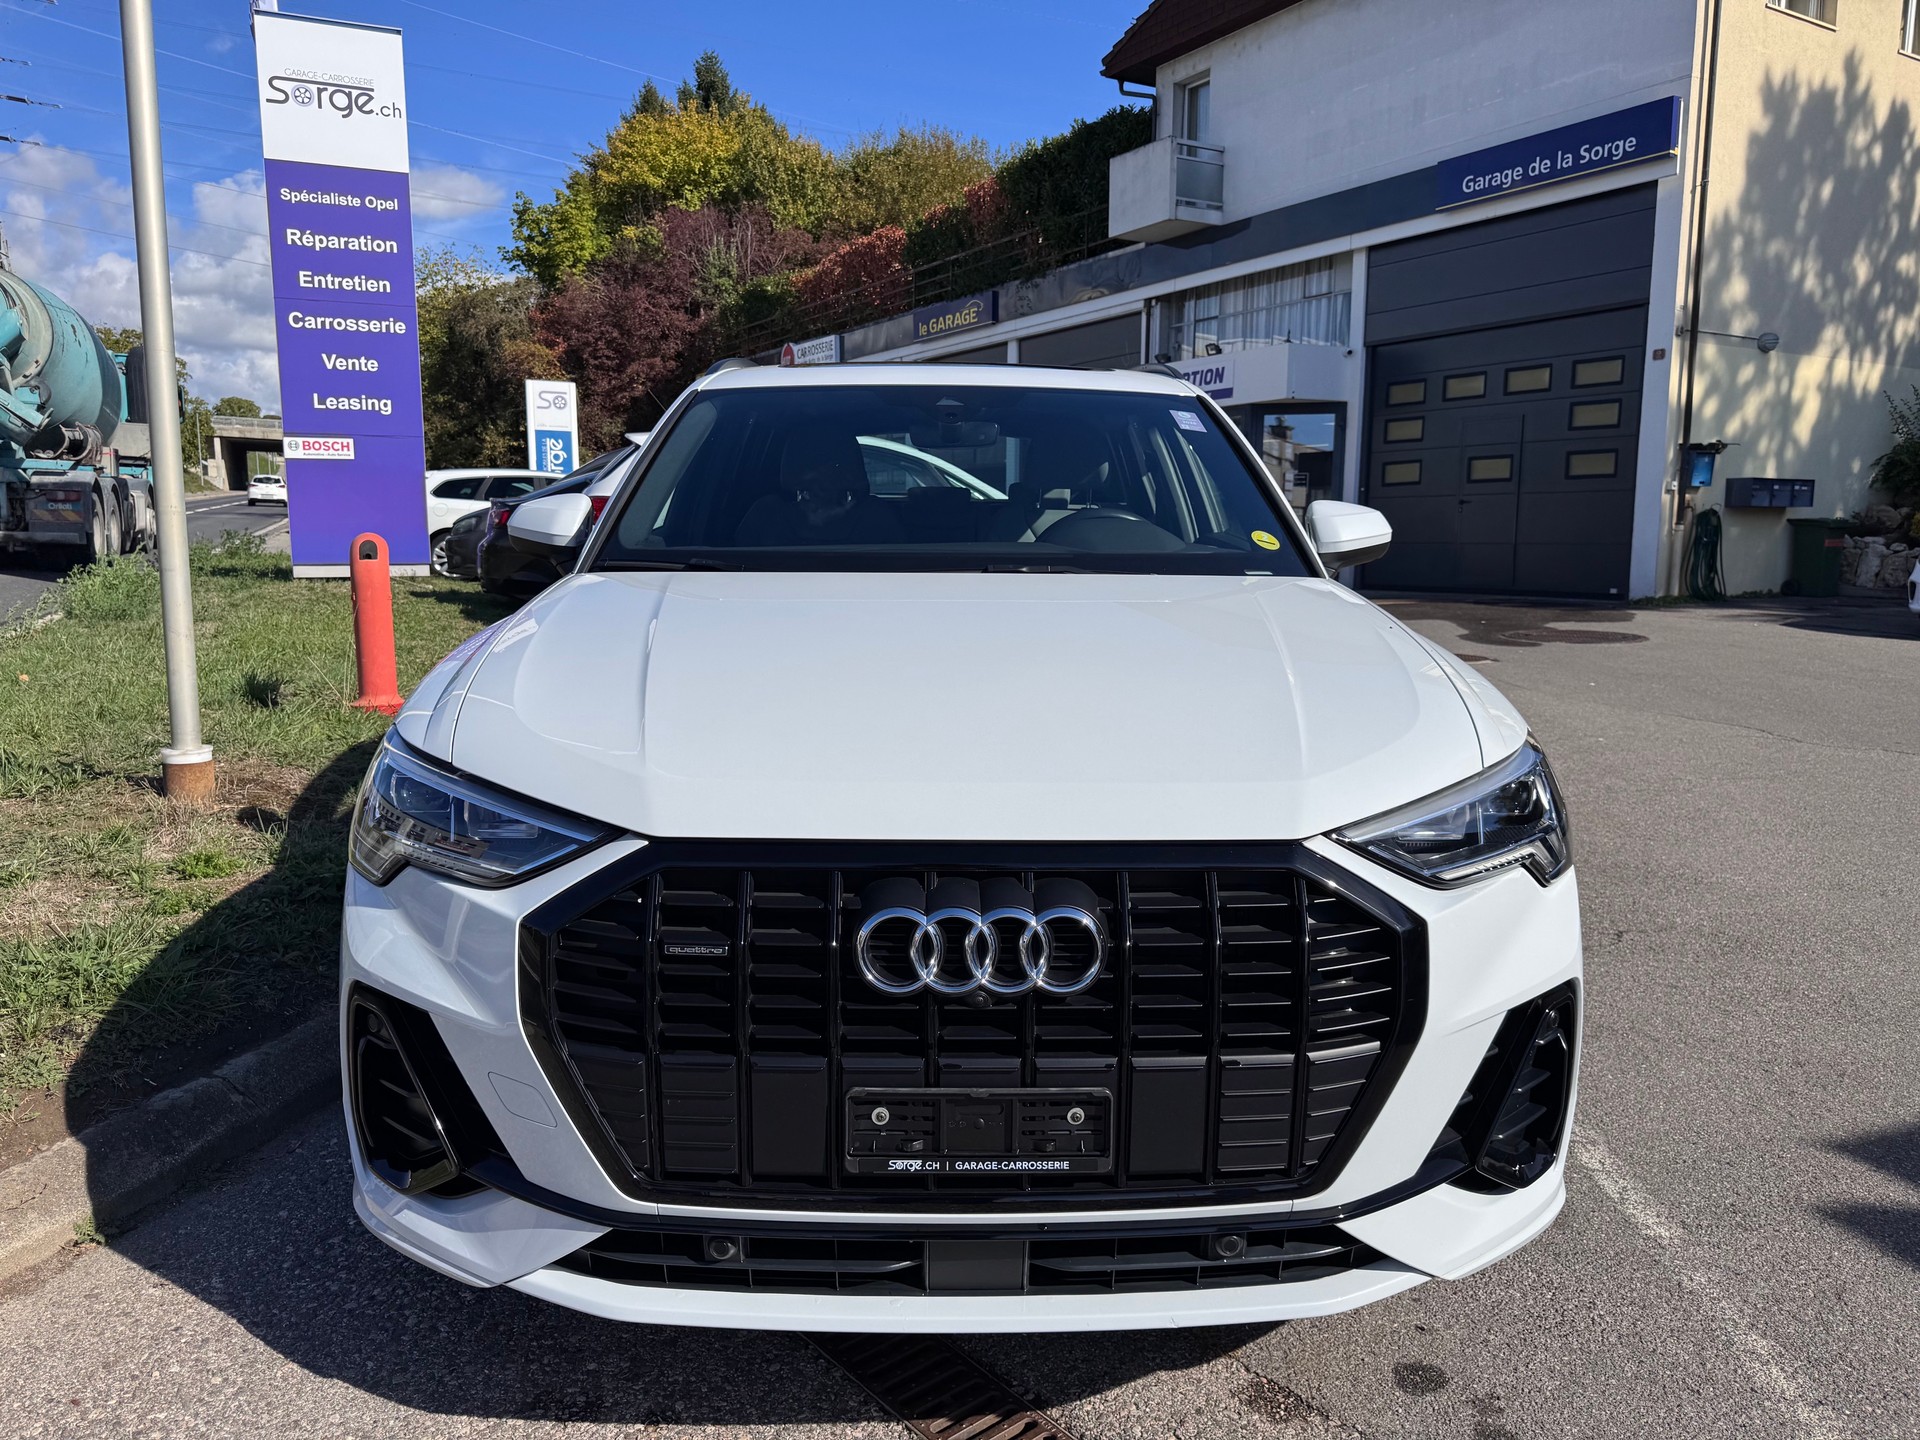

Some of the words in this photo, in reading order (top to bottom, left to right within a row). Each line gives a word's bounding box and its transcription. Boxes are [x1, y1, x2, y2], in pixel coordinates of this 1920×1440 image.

[284, 67, 374, 87] GARAGE-CARROSSERIE
[1462, 166, 1523, 193] Garage
[1528, 156, 1550, 176] de
[1557, 150, 1573, 170] la
[1579, 136, 1637, 164] Sorge
[280, 187, 361, 207] Spécialiste
[364, 195, 399, 212] Opel
[286, 228, 398, 254] Réparation
[298, 270, 391, 294] Entretien
[288, 311, 407, 335] Carrosserie
[918, 322, 928, 337] le
[929, 307, 979, 334] GARAGE
[797, 339, 834, 360] CARROSSERIE
[321, 353, 379, 373] Vente
[313, 393, 393, 416] Leasing
[302, 440, 350, 452] BOSCH
[669, 946, 723, 955] quattro
[955, 1161, 1070, 1171] GARAGE-CARROSSERIE
